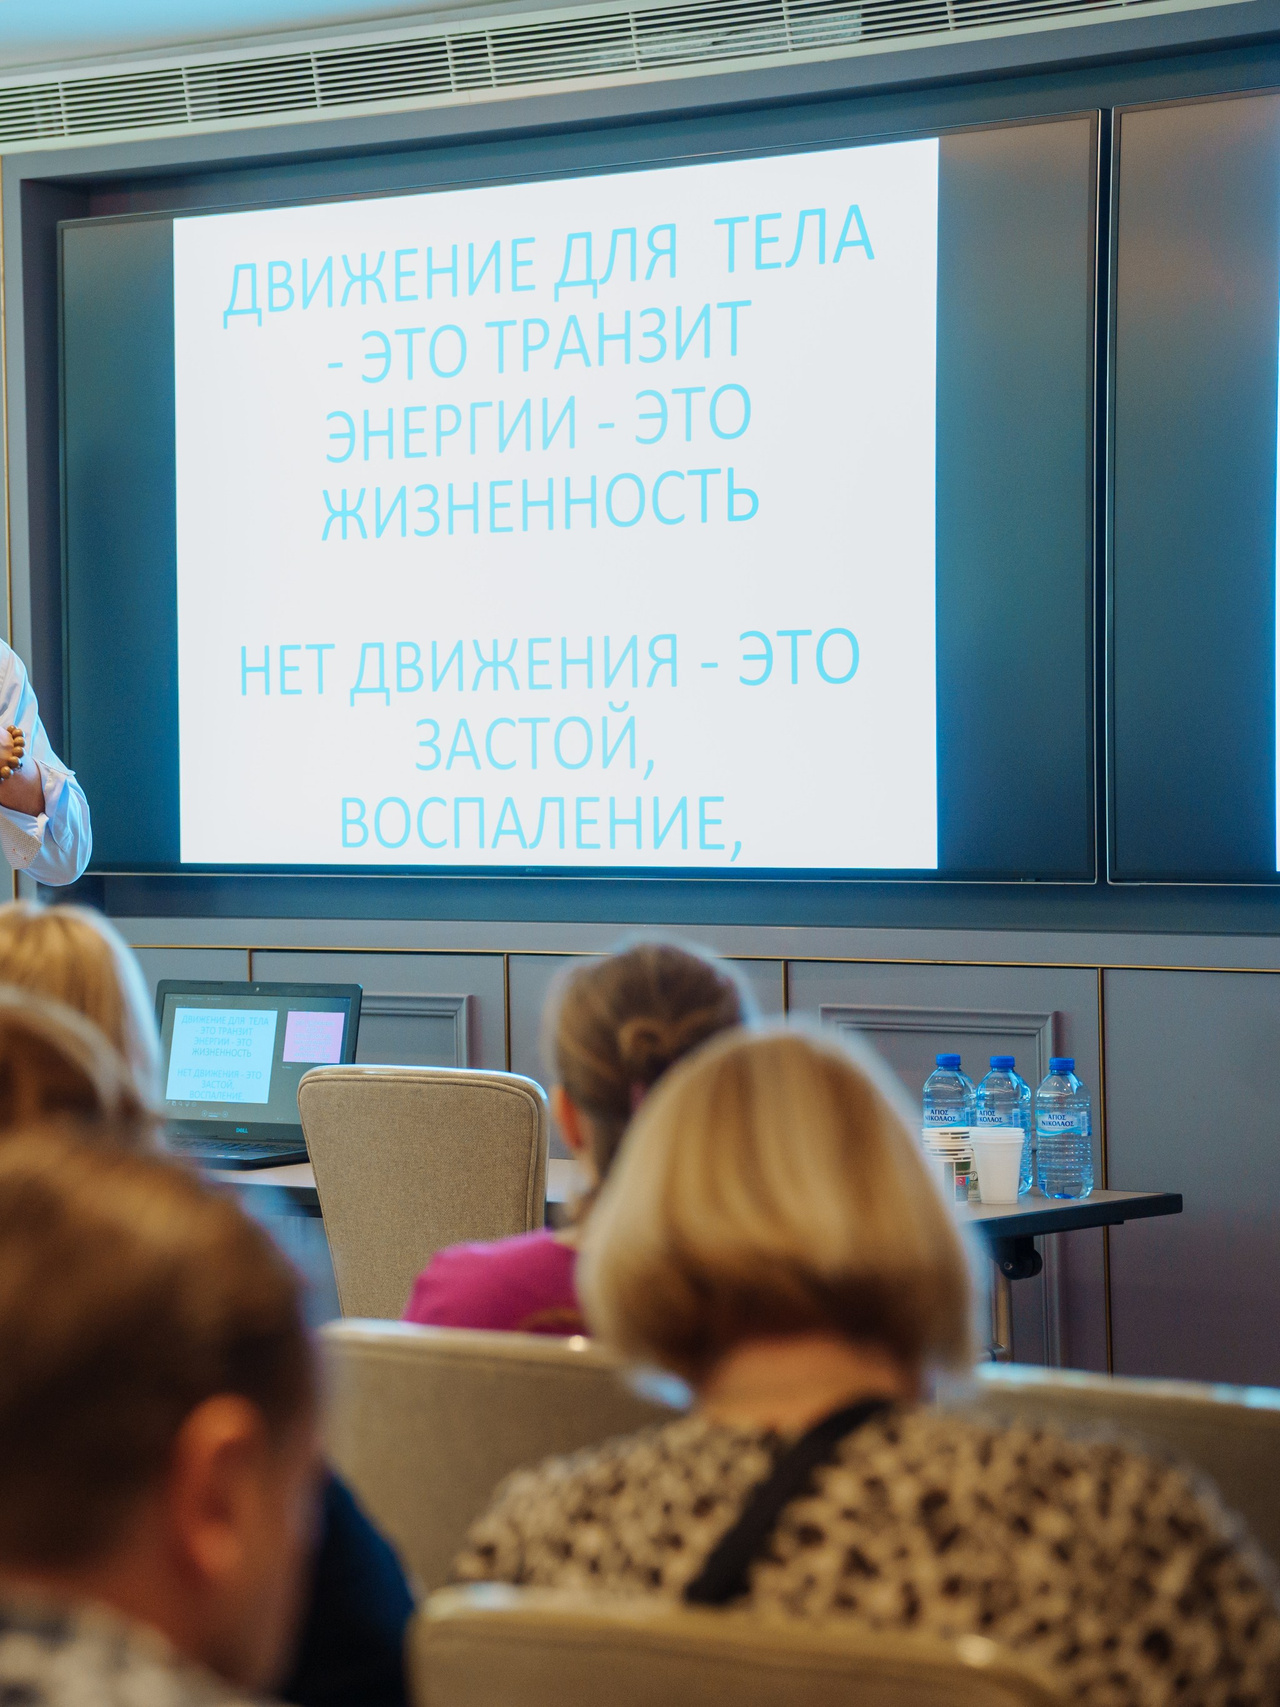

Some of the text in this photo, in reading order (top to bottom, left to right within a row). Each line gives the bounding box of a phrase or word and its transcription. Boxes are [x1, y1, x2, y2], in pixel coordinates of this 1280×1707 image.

[223, 204, 875, 329] ДВИЖЕНИЕ ДЛЯ ТЕЛА
[361, 324, 467, 384] ЭТО
[485, 300, 752, 374] ТРАНЗИТ
[325, 396, 576, 464] ЭНЕРГИИ
[636, 384, 752, 444] ЭТО
[322, 467, 760, 540] ЖИЗНЕННОСТЬ
[241, 644, 336, 697] НЕТ
[349, 634, 678, 707] ДВИЖЕНИЯ
[738, 628, 860, 687] ЭТО
[415, 700, 655, 780] ЗАСТОЙ,
[340, 796, 742, 862] ВОСПАЛЕНИЕ,
[181, 1014, 269, 1026] ДВИЖЕНИЕ ДЛЯ ТЕЛА
[191, 1047, 252, 1058] ЖИЗНЕННОСТЬ
[193, 1036, 230, 1046] ЭНЕРГИИ
[237, 1037, 253, 1047] ЭТО
[217, 1026, 254, 1036] ТРАНЗИТ
[177, 1068, 193, 1078] НЕТ
[193, 1068, 240, 1079] ДВИЖЕНИЯ
[246, 1070, 263, 1080] ЭТО
